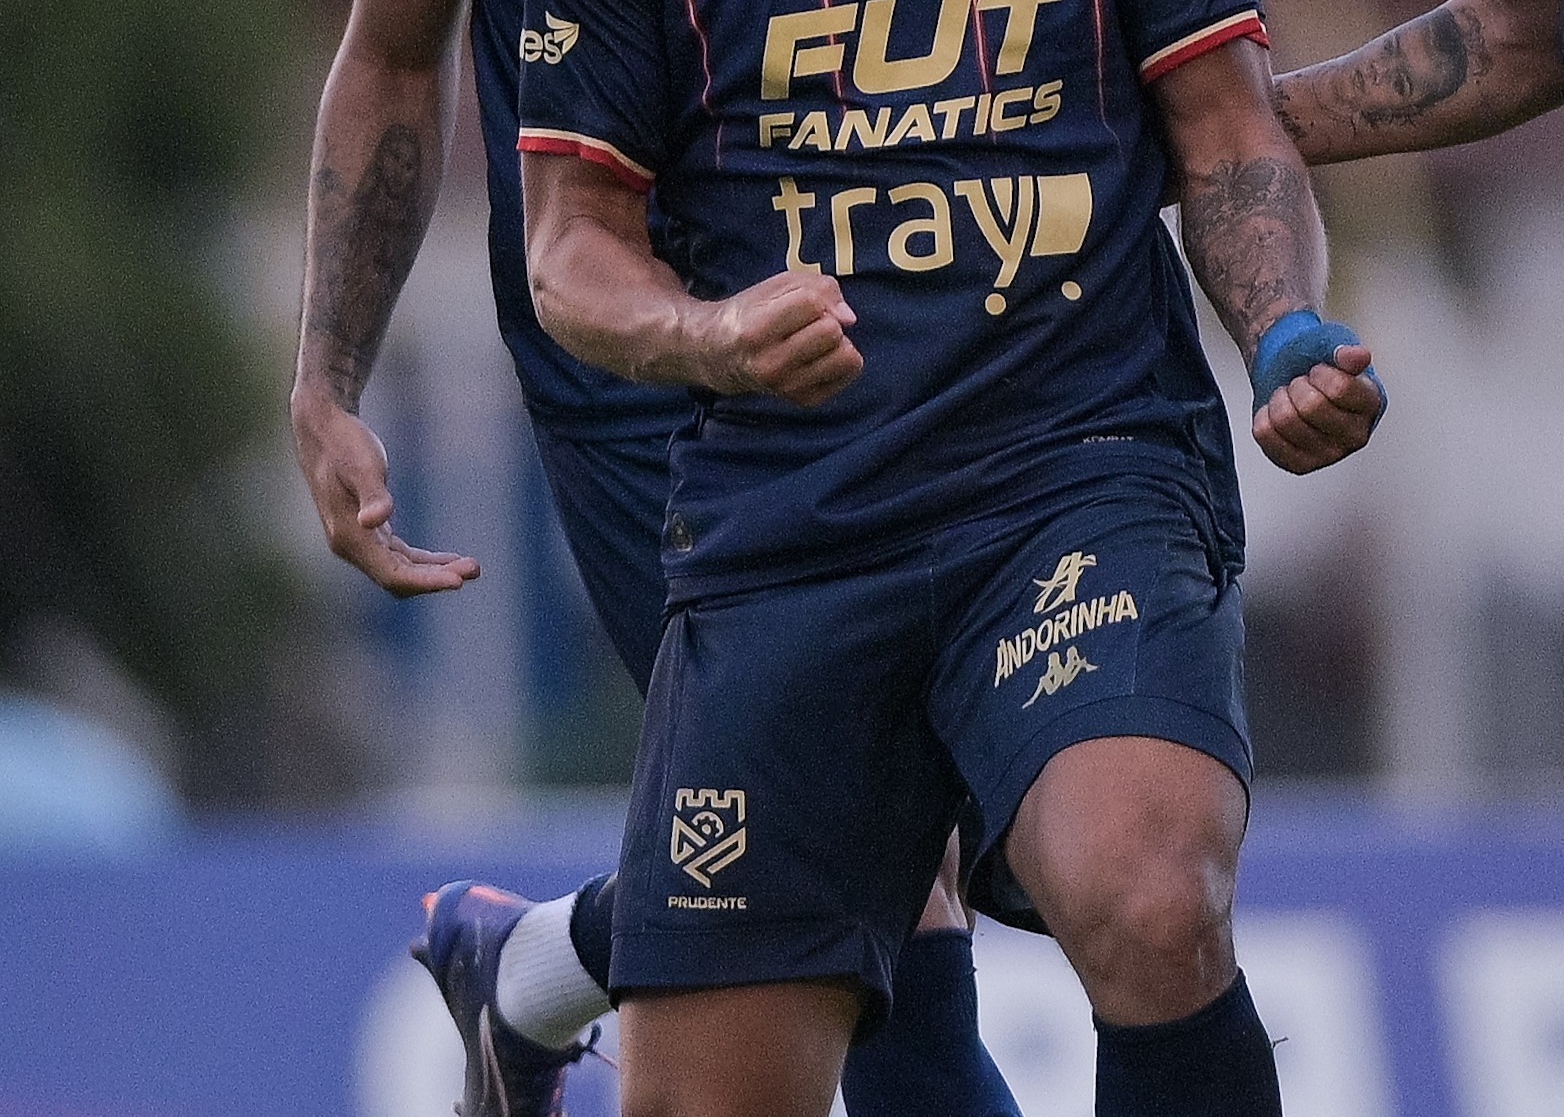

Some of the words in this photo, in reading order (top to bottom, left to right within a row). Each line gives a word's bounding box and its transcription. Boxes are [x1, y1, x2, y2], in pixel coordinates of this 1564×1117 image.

[759, 80, 1064, 152] FANATICS
[772, 175, 1034, 288] tray
[994, 590, 1139, 688] ANDORINHA
[668, 895, 748, 910] PRUDENTE
